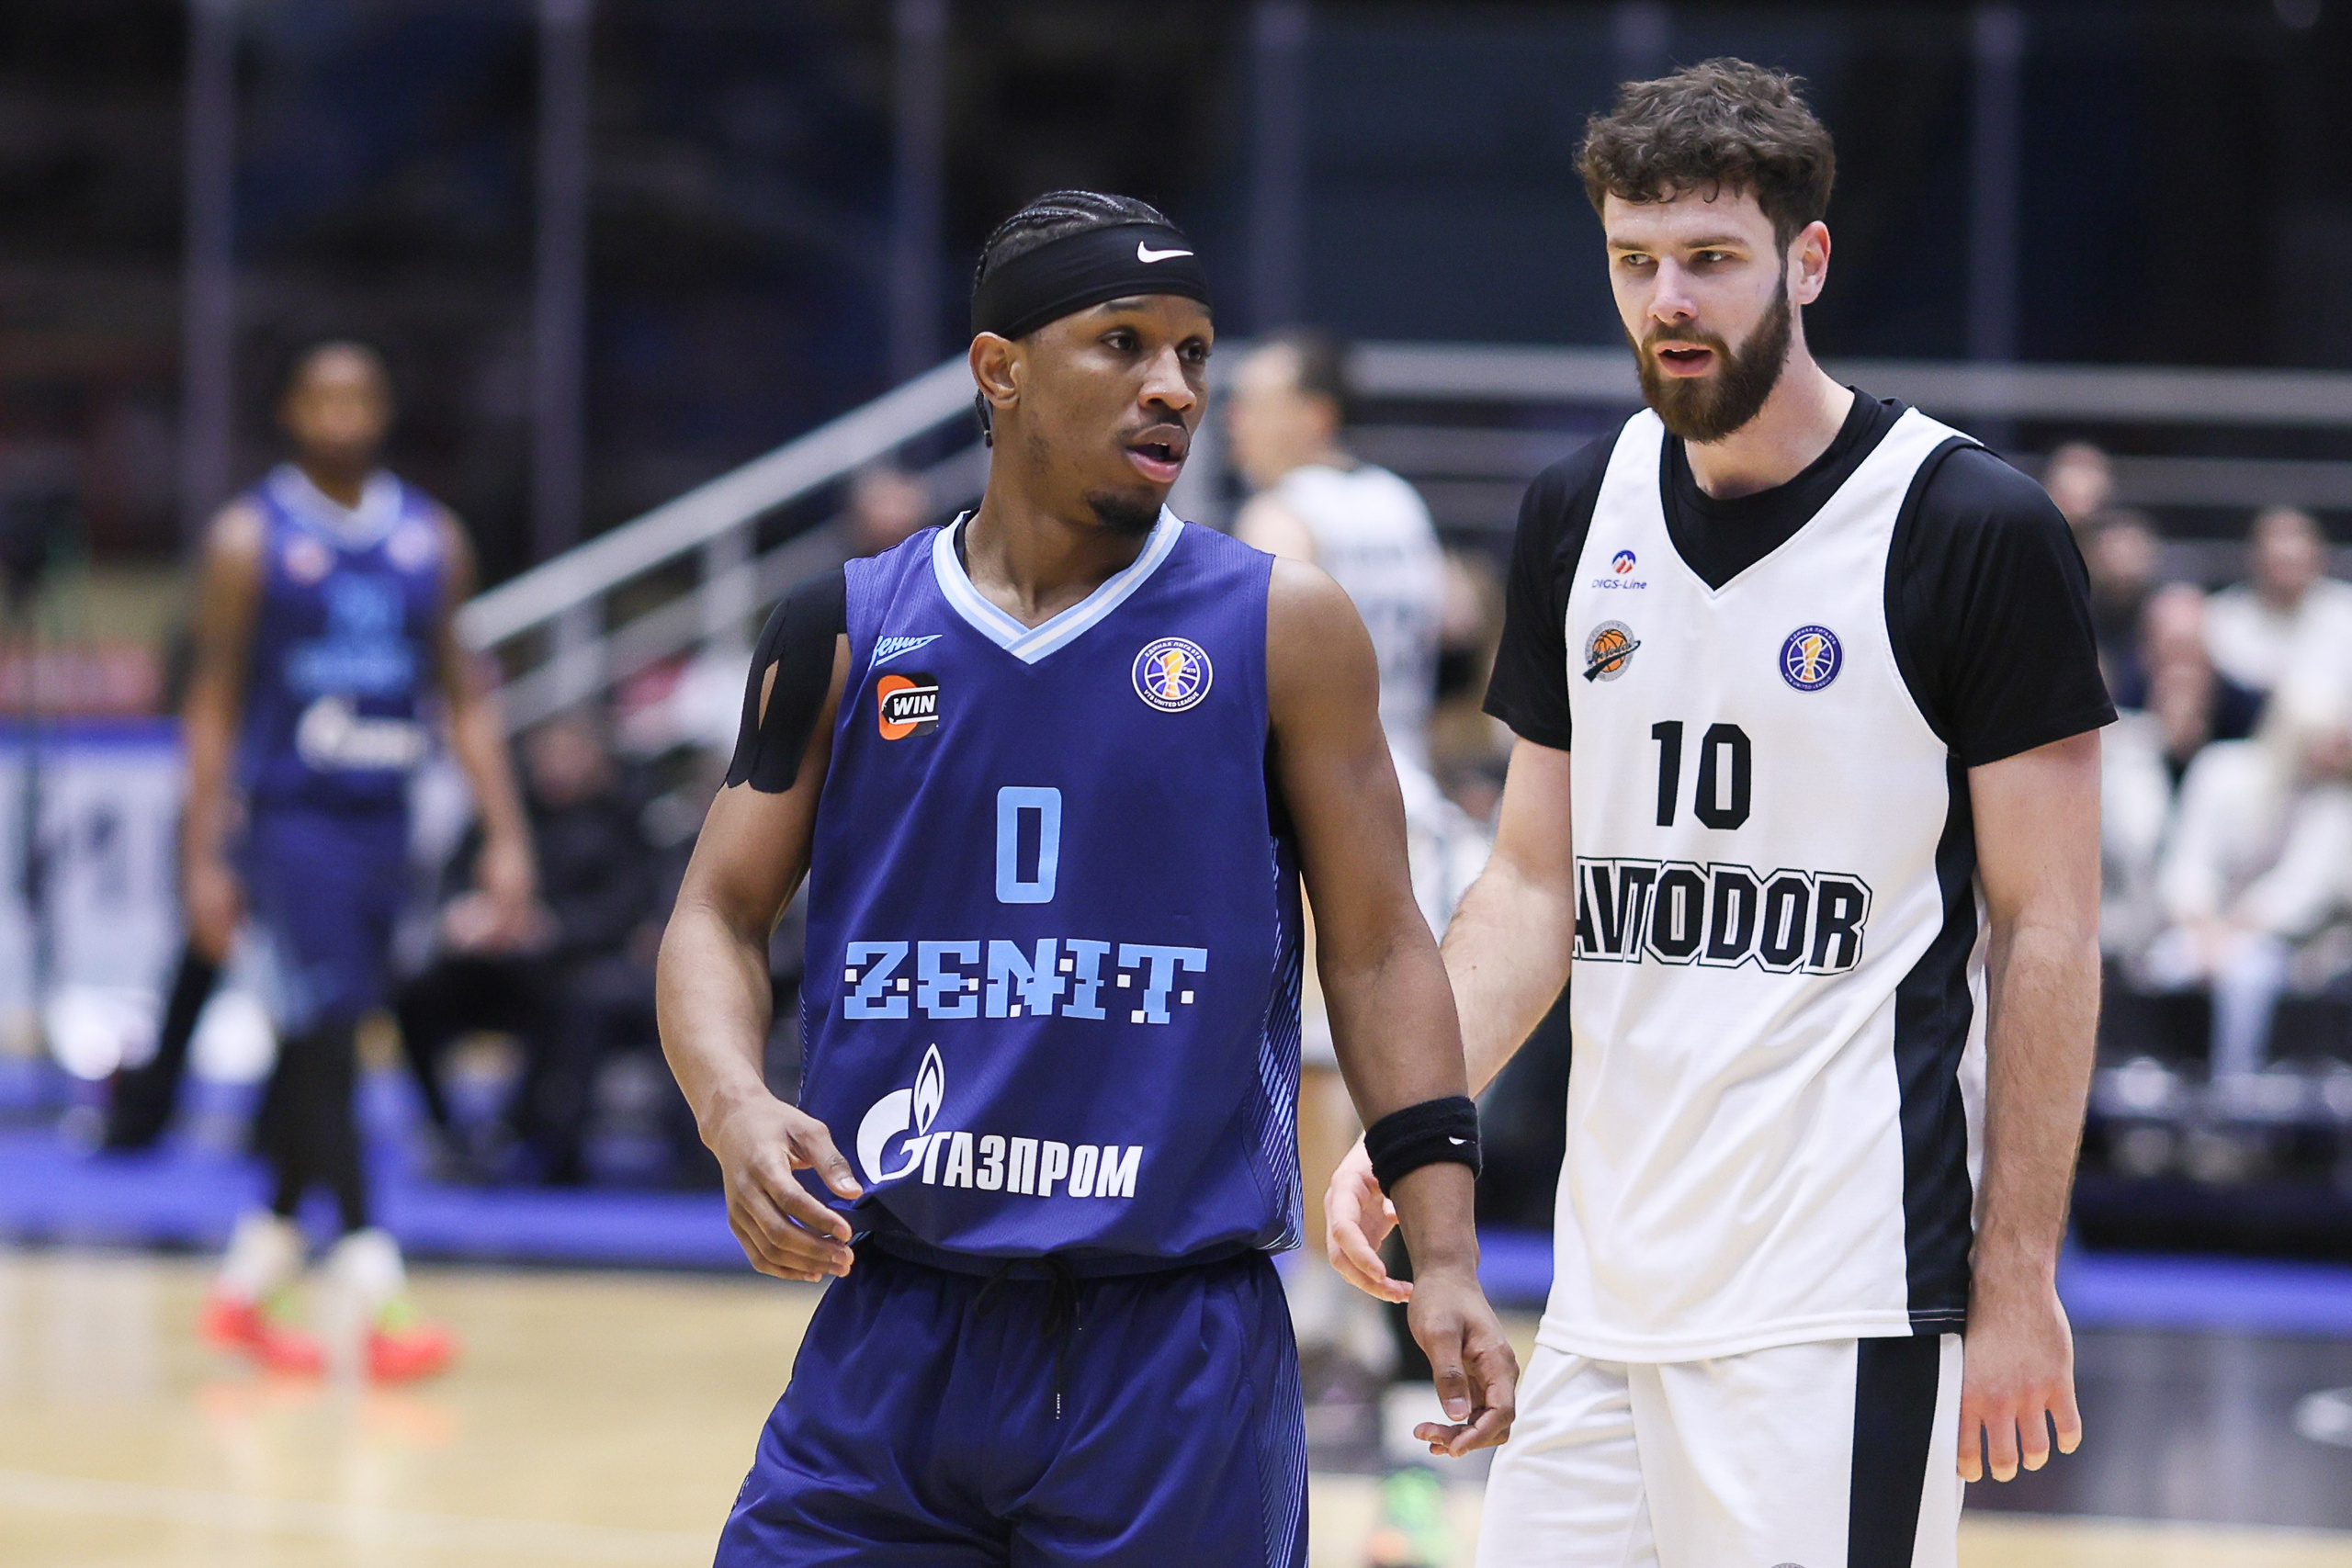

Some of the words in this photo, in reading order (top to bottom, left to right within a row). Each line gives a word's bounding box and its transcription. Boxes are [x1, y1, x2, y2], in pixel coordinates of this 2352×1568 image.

[1144, 641, 1172, 658] ЕДИНАЯ
[1172, 641, 1192, 652] ЛИГА
[893, 694, 936, 716] WIN
[1143, 689, 1155, 701] VTB
[1153, 697, 1177, 707] UNITED
[1177, 691, 1200, 706] LEAGUE
[1651, 720, 1751, 830] 10
[996, 786, 1062, 903] 0
[843, 938, 1208, 1024] ZENIT
[922, 1131, 1143, 1198] ГАЗПРОМ
